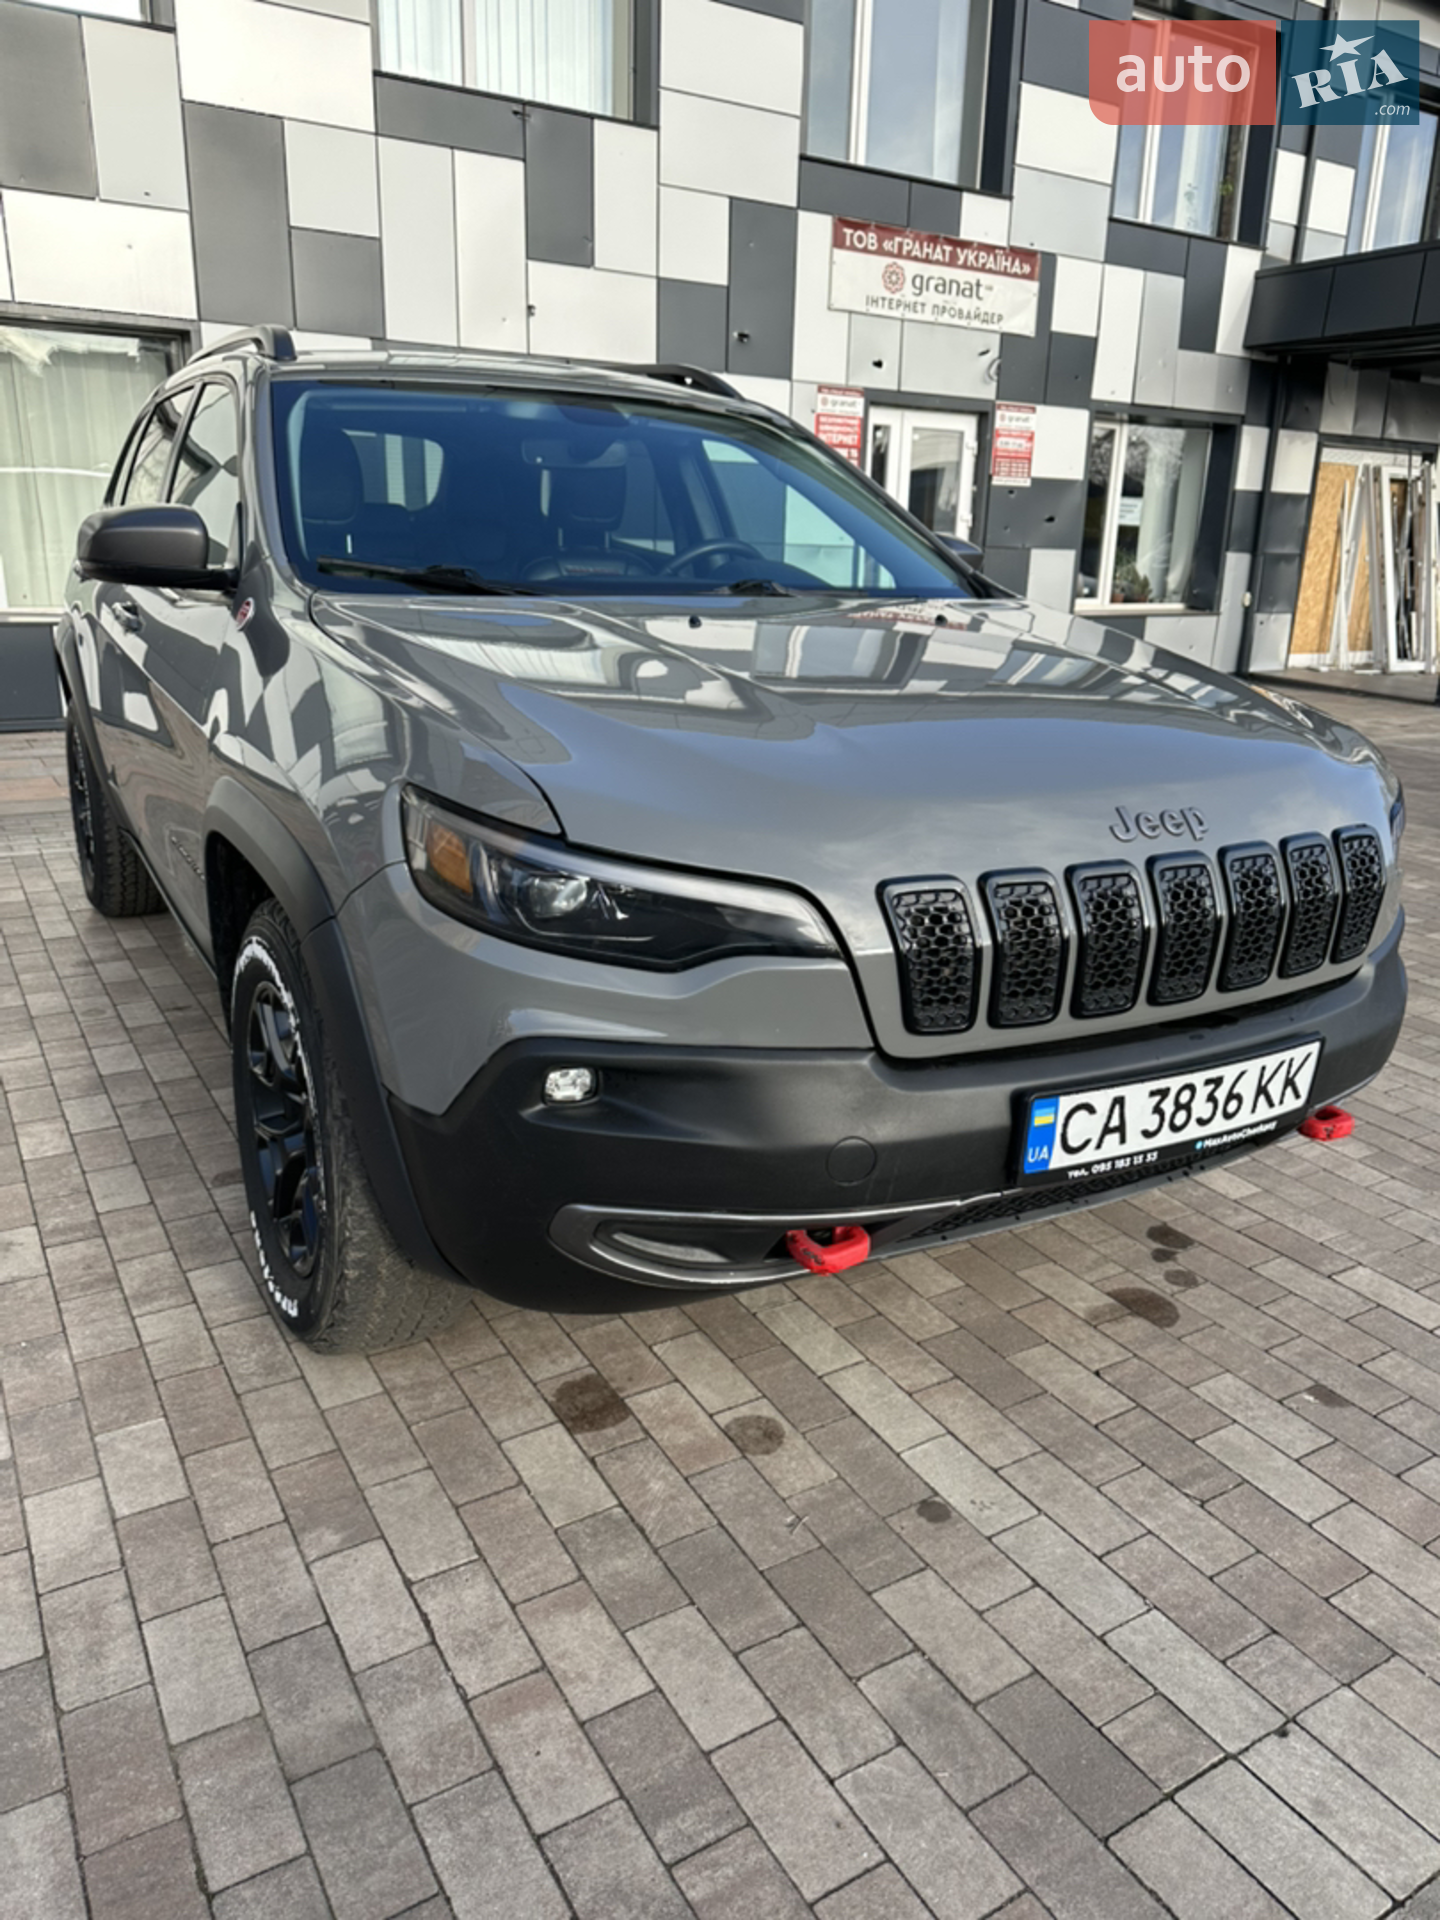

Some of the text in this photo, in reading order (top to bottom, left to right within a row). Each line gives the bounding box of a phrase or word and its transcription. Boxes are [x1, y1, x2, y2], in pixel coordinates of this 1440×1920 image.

[842, 227, 1032, 275] ТОВ «ГРАНАТ УКРАЇНА»
[911, 273, 984, 301] granat
[865, 294, 1004, 325] ІНТЕРНЕТ ПРОВАЙДЕР
[1109, 805, 1209, 843] Jeep
[1060, 1051, 1313, 1154] CA 3836 KK
[1027, 1145, 1050, 1163] UA
